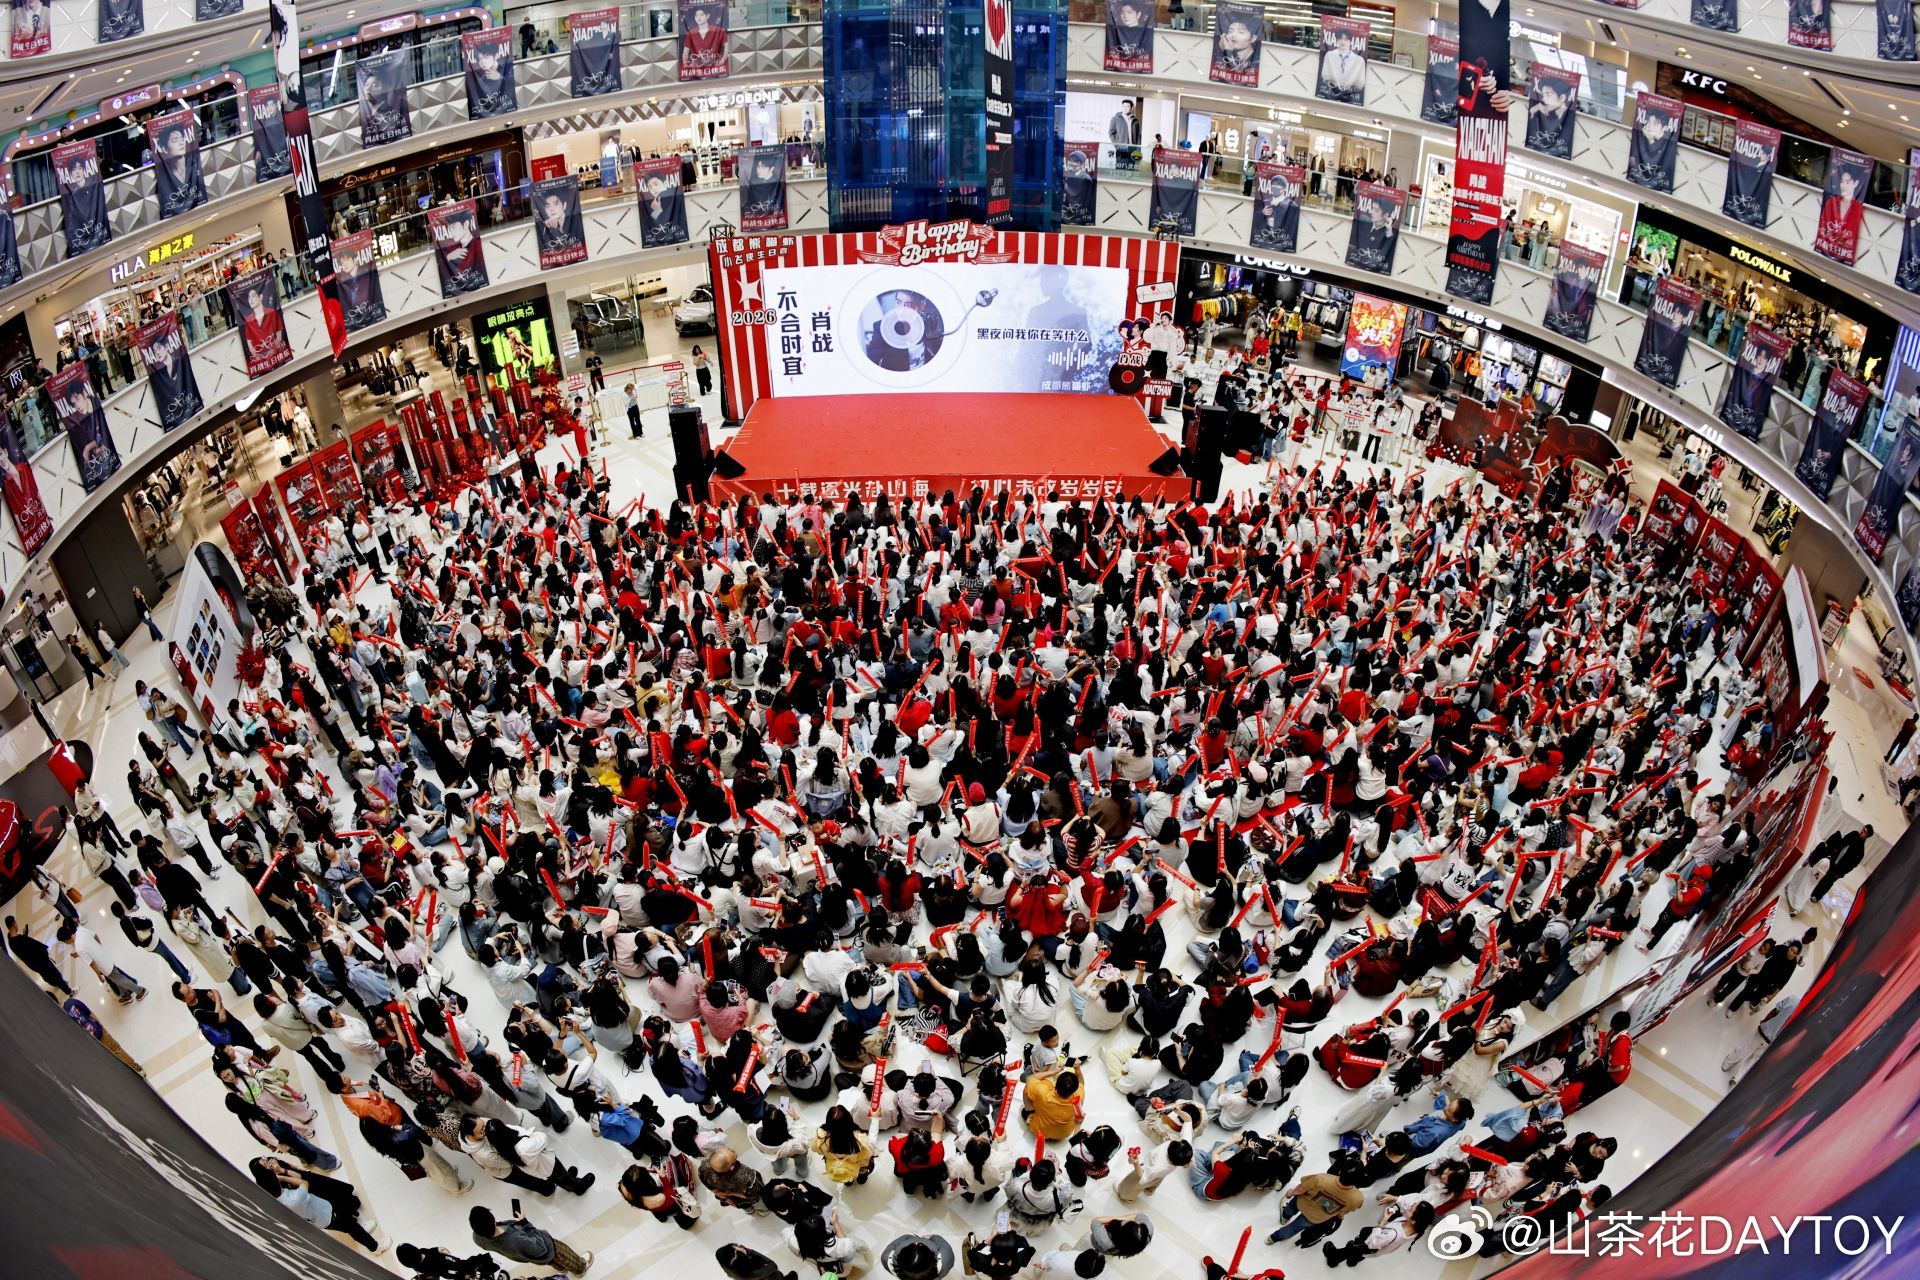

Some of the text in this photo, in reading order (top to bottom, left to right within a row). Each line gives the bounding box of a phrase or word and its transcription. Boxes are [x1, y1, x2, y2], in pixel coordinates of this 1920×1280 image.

[681, 67, 726, 77] 肖战生日快乐
[1681, 71, 1727, 95] KFC
[731, 90, 780, 105] JOEONE
[1458, 116, 1506, 165] XIAOZHAN
[1469, 173, 1487, 189] 肖战
[906, 221, 970, 247] Happy
[716, 237, 794, 253] 成都熊猫虾
[900, 237, 981, 266] Birthday
[111, 233, 194, 284] HLA 海澜之家
[1730, 246, 1792, 283] POLOWALK
[732, 310, 777, 325] 2026
[777, 291, 803, 376] 不合时宜
[811, 312, 833, 353] 肖战
[977, 328, 1088, 342] 黑夜问我你在等什么
[1119, 353, 1143, 365] 肖战
[1042, 381, 1091, 391] 成都熊猫虾
[1143, 384, 1172, 396] XIAOZHAN
